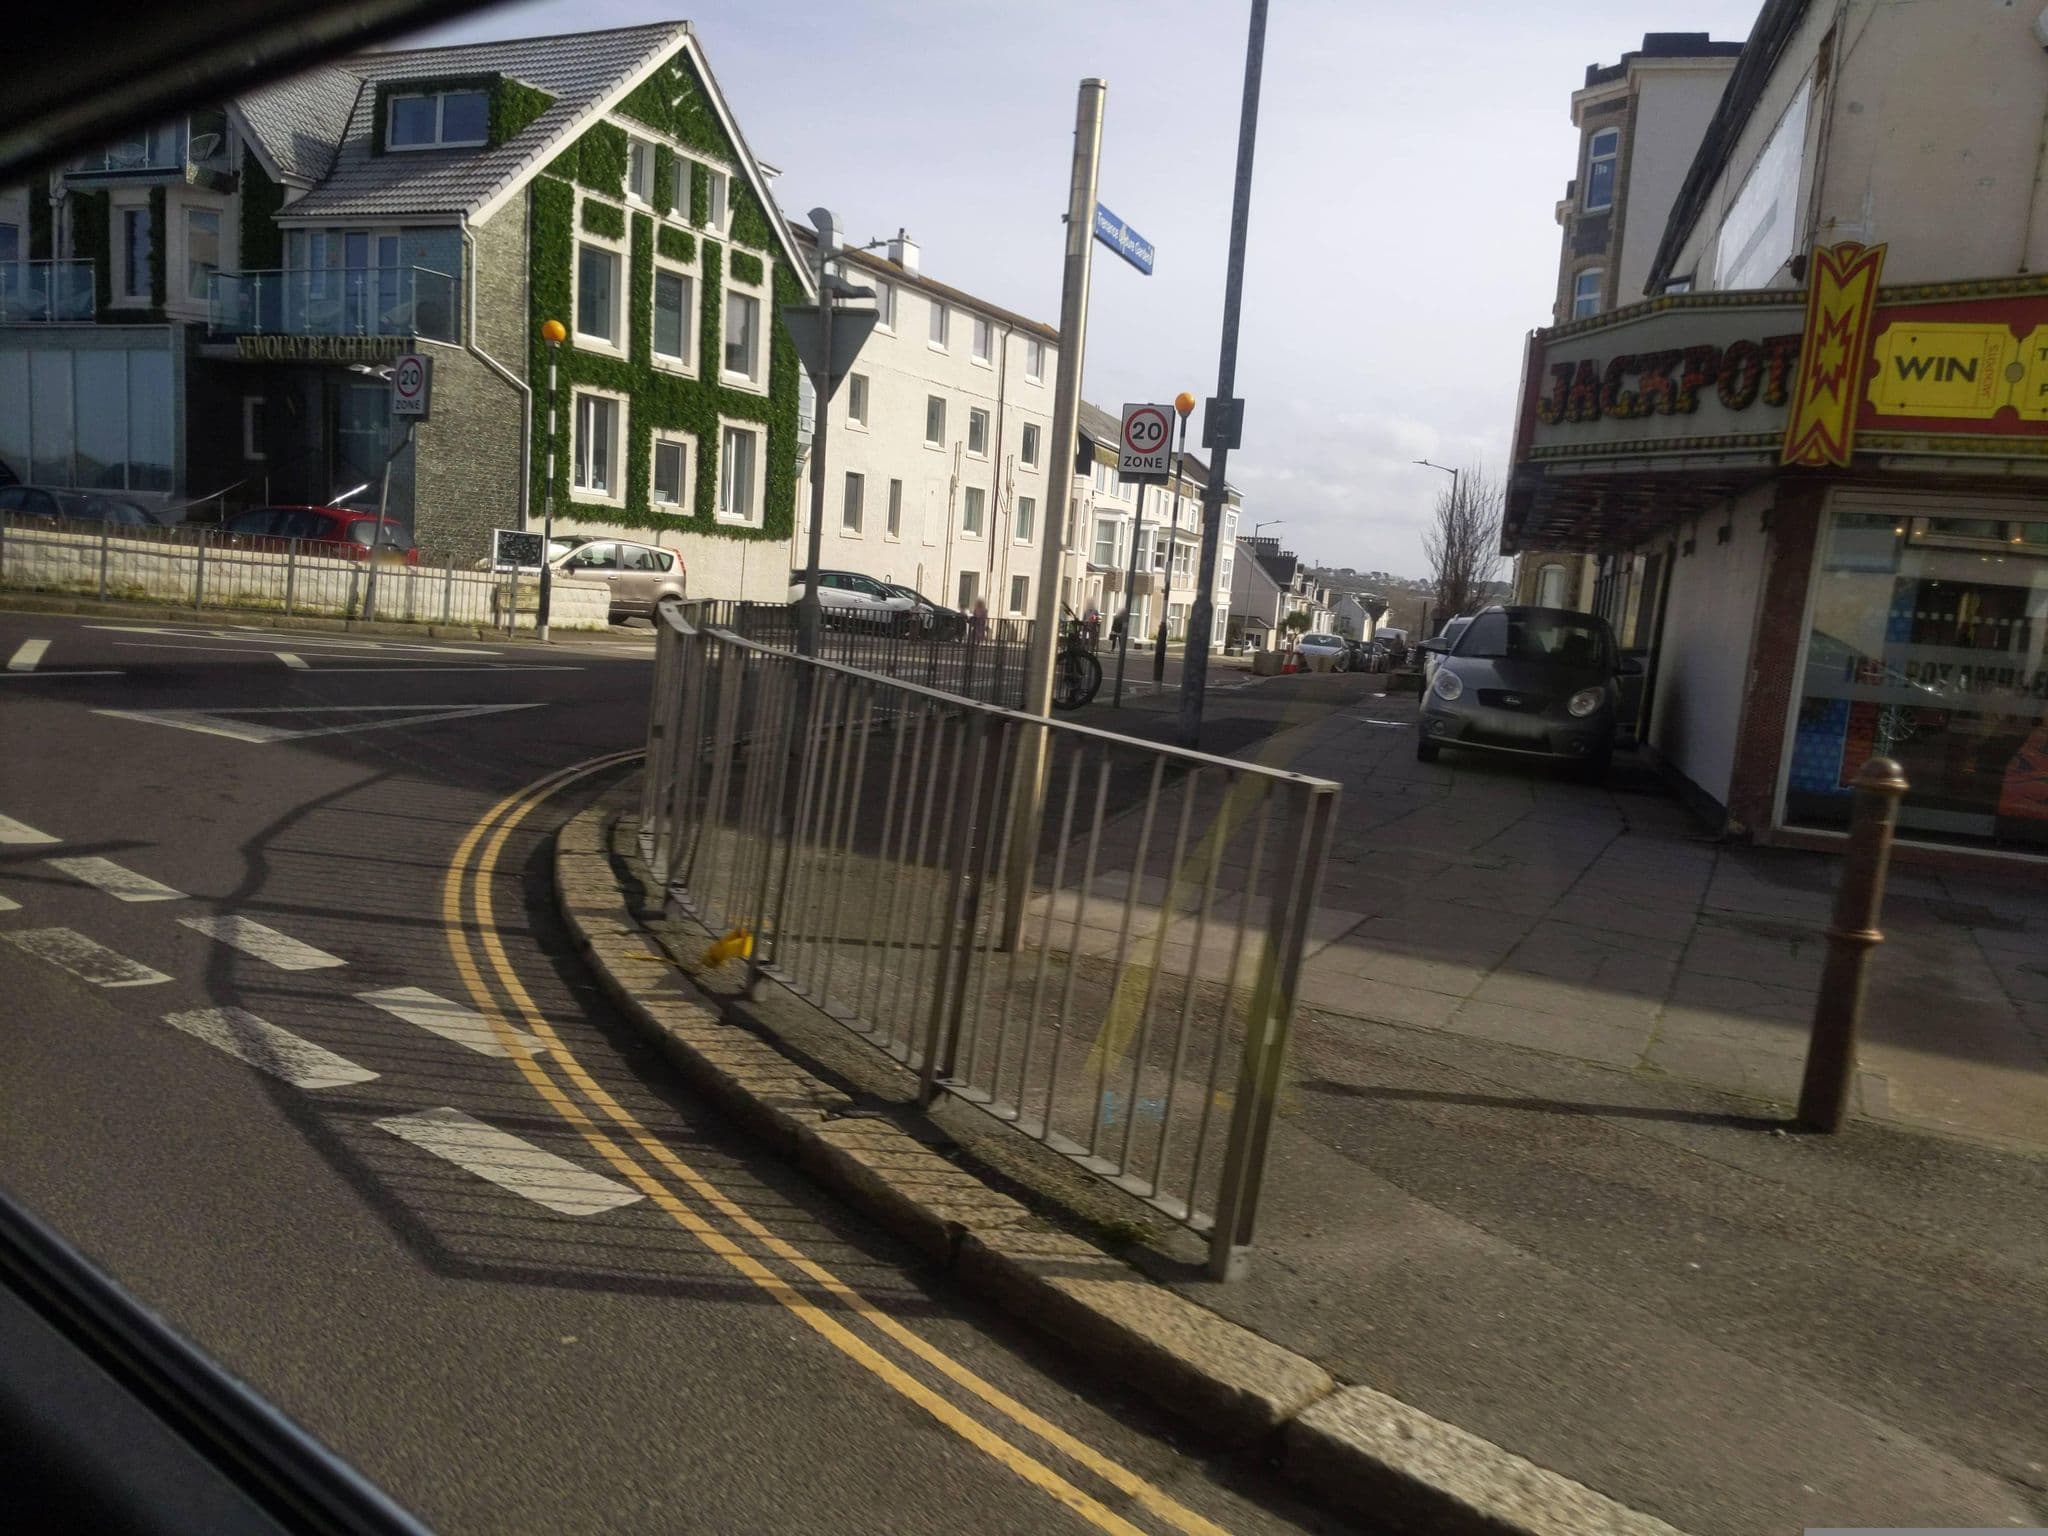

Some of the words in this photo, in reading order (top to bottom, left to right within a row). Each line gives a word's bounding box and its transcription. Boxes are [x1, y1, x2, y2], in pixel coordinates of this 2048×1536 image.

[236, 335, 304, 360] NEWQUAY
[308, 335, 357, 360] BEACH
[400, 369, 418, 386] 20
[1894, 354, 1978, 383] WIN
[1535, 333, 1803, 425] JACKPOT
[395, 399, 421, 411] ZONE
[1131, 421, 1162, 441] 20
[1123, 455, 1163, 469] ZONE
